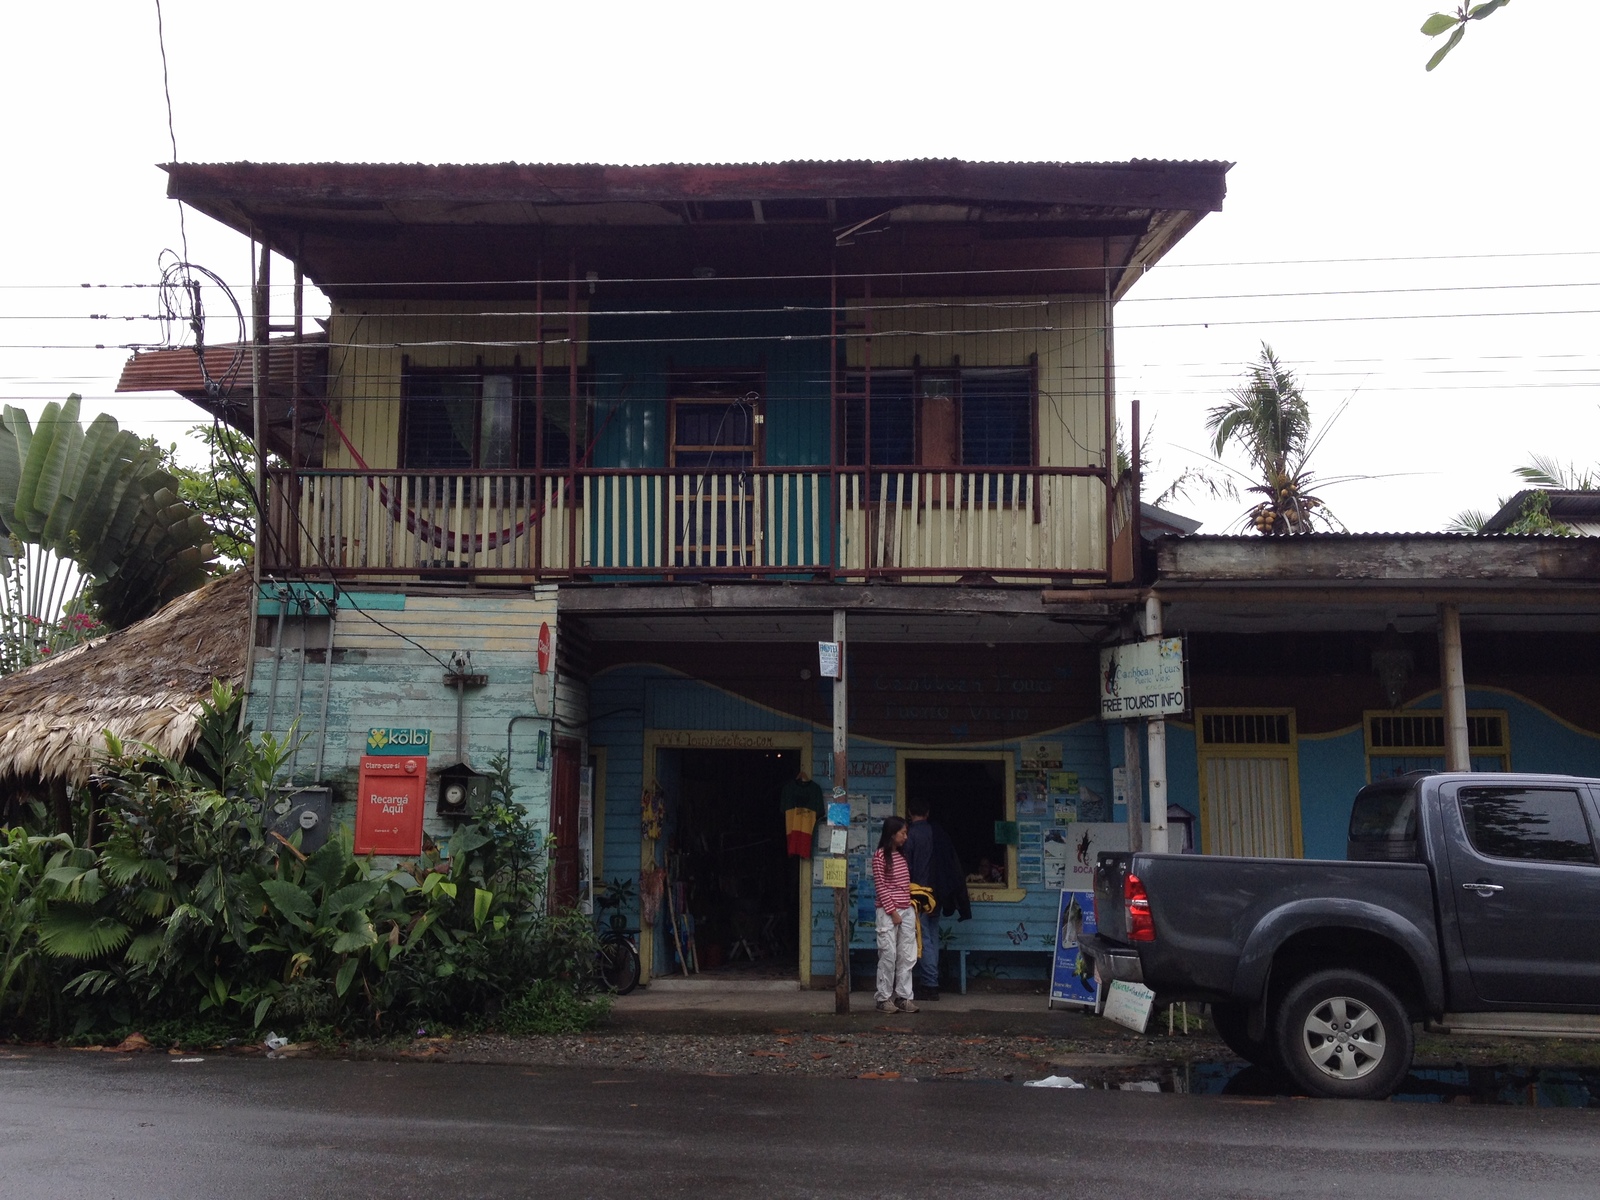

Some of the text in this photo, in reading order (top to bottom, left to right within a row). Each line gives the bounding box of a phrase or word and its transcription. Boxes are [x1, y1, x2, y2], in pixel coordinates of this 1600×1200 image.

[1116, 664, 1181, 680] Caribbean Tours
[1102, 691, 1183, 713] FREE TOURIST INFO
[370, 794, 409, 806] Recargá
[382, 803, 404, 815] Aquí
